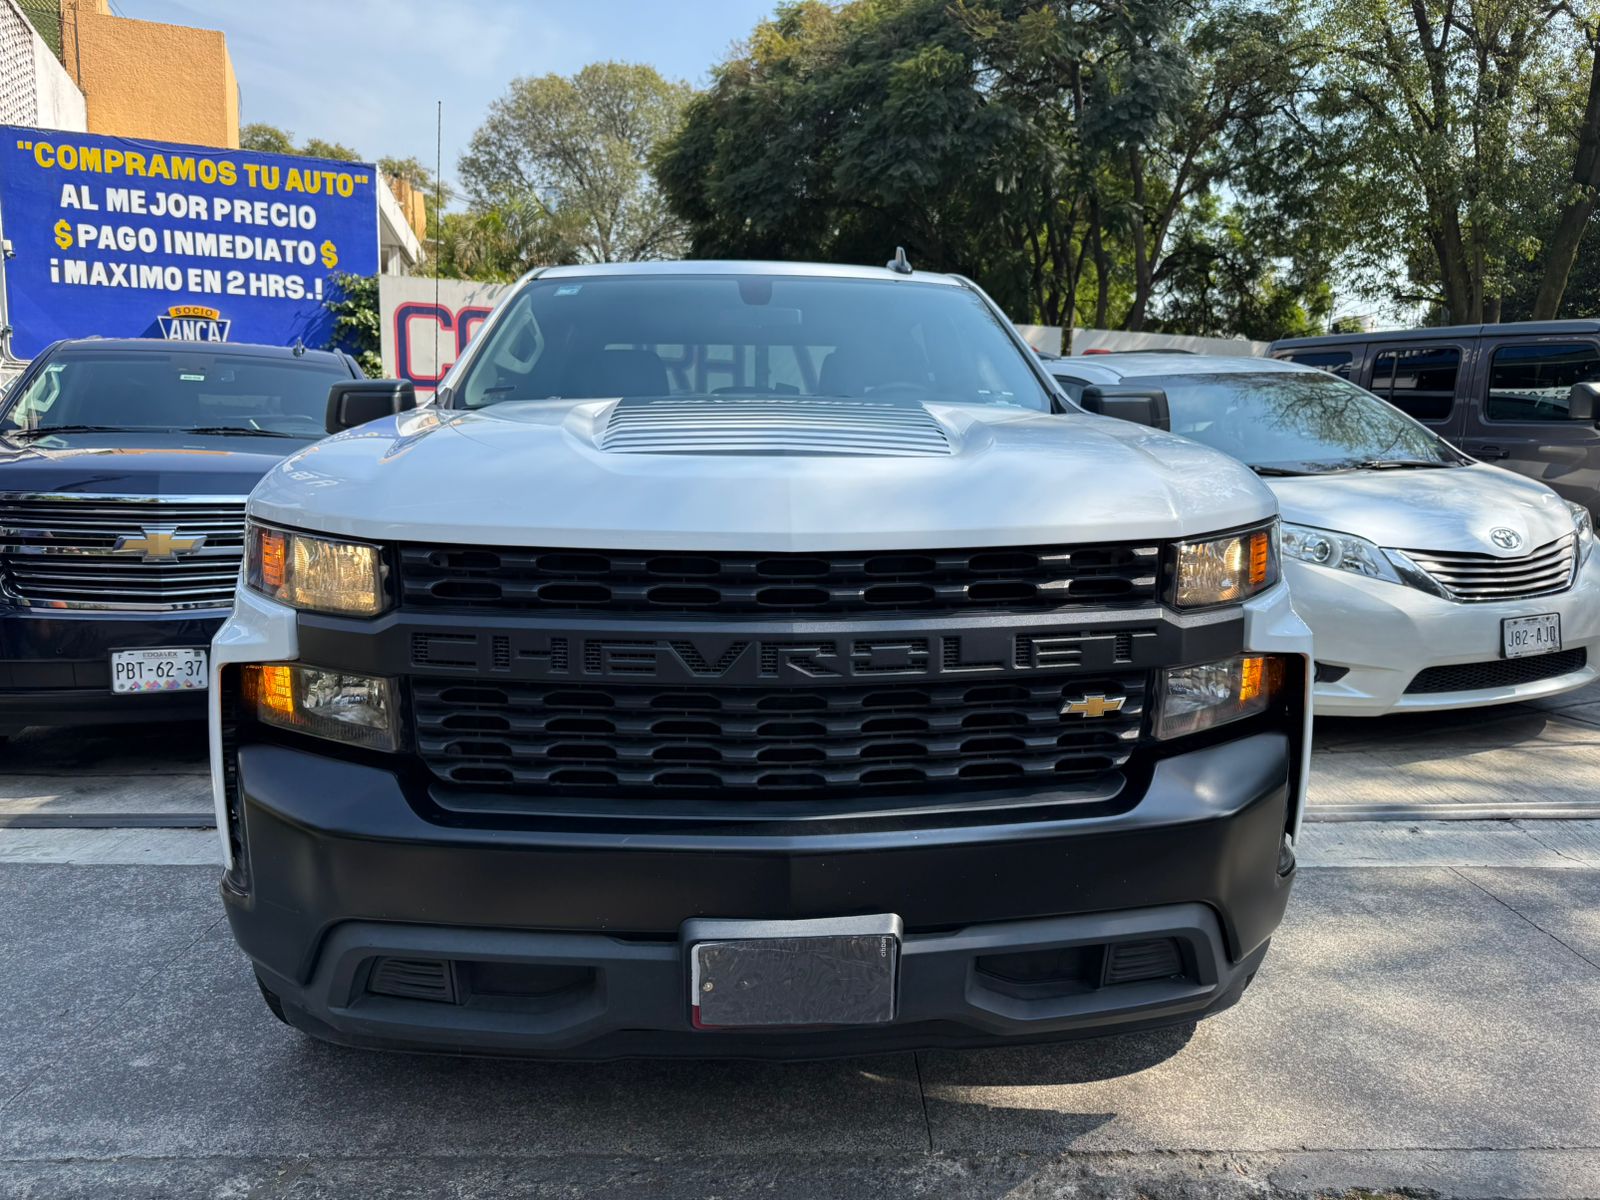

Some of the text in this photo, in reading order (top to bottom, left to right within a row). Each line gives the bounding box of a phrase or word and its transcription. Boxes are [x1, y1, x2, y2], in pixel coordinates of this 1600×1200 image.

[17, 140, 369, 198] "COMPRAMOS TU AUTO"
[60, 184, 317, 230] AL MEJOR PRECIO
[187, 268, 222, 294] EN
[226, 270, 246, 295] 2
[174, 306, 213, 317] SOCIO
[168, 319, 221, 342] ANCA
[411, 626, 1158, 679] CHEVROLET
[115, 660, 203, 680] PBT-62-37
